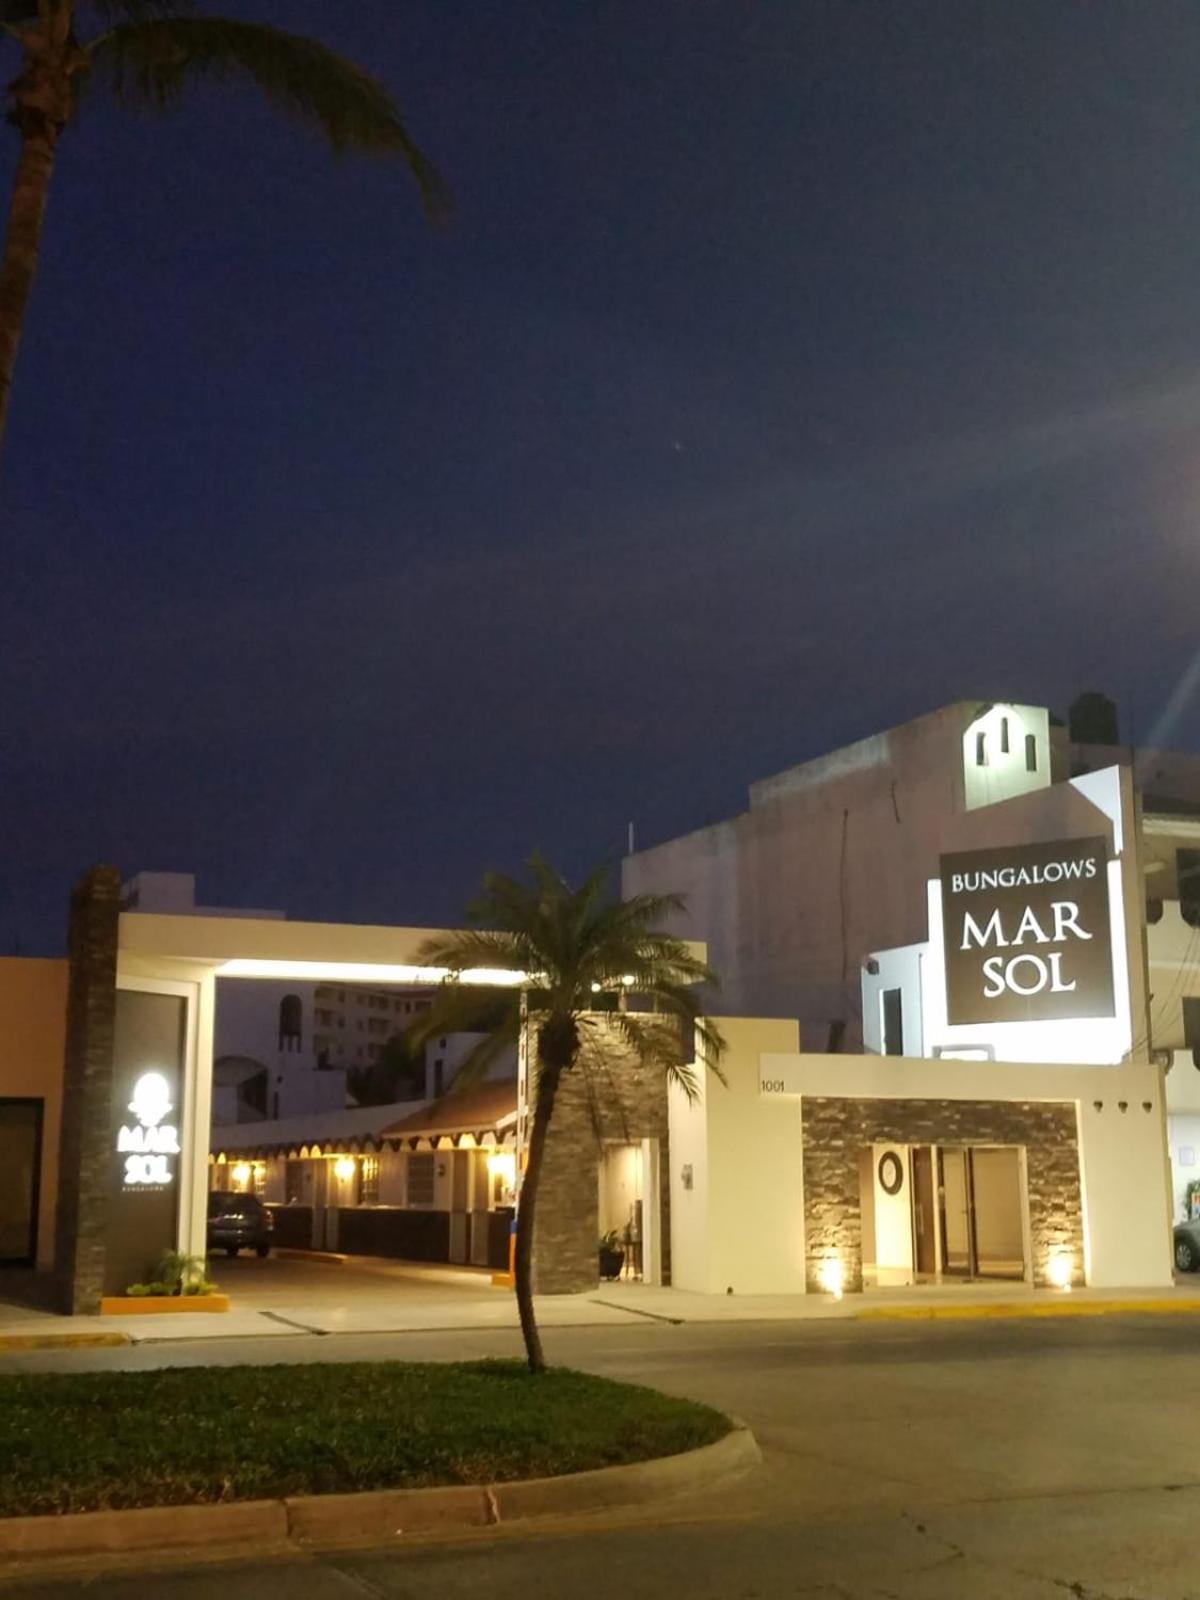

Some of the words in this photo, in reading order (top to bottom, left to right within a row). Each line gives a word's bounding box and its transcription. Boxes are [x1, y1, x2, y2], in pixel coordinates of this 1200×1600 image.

[952, 858, 1096, 893] BUNGALOWS
[960, 901, 1093, 950] MAR
[983, 952, 1076, 998] SOL
[762, 1080, 784, 1093] 1001
[117, 1124, 181, 1153] MAR
[124, 1154, 173, 1184] SOL
